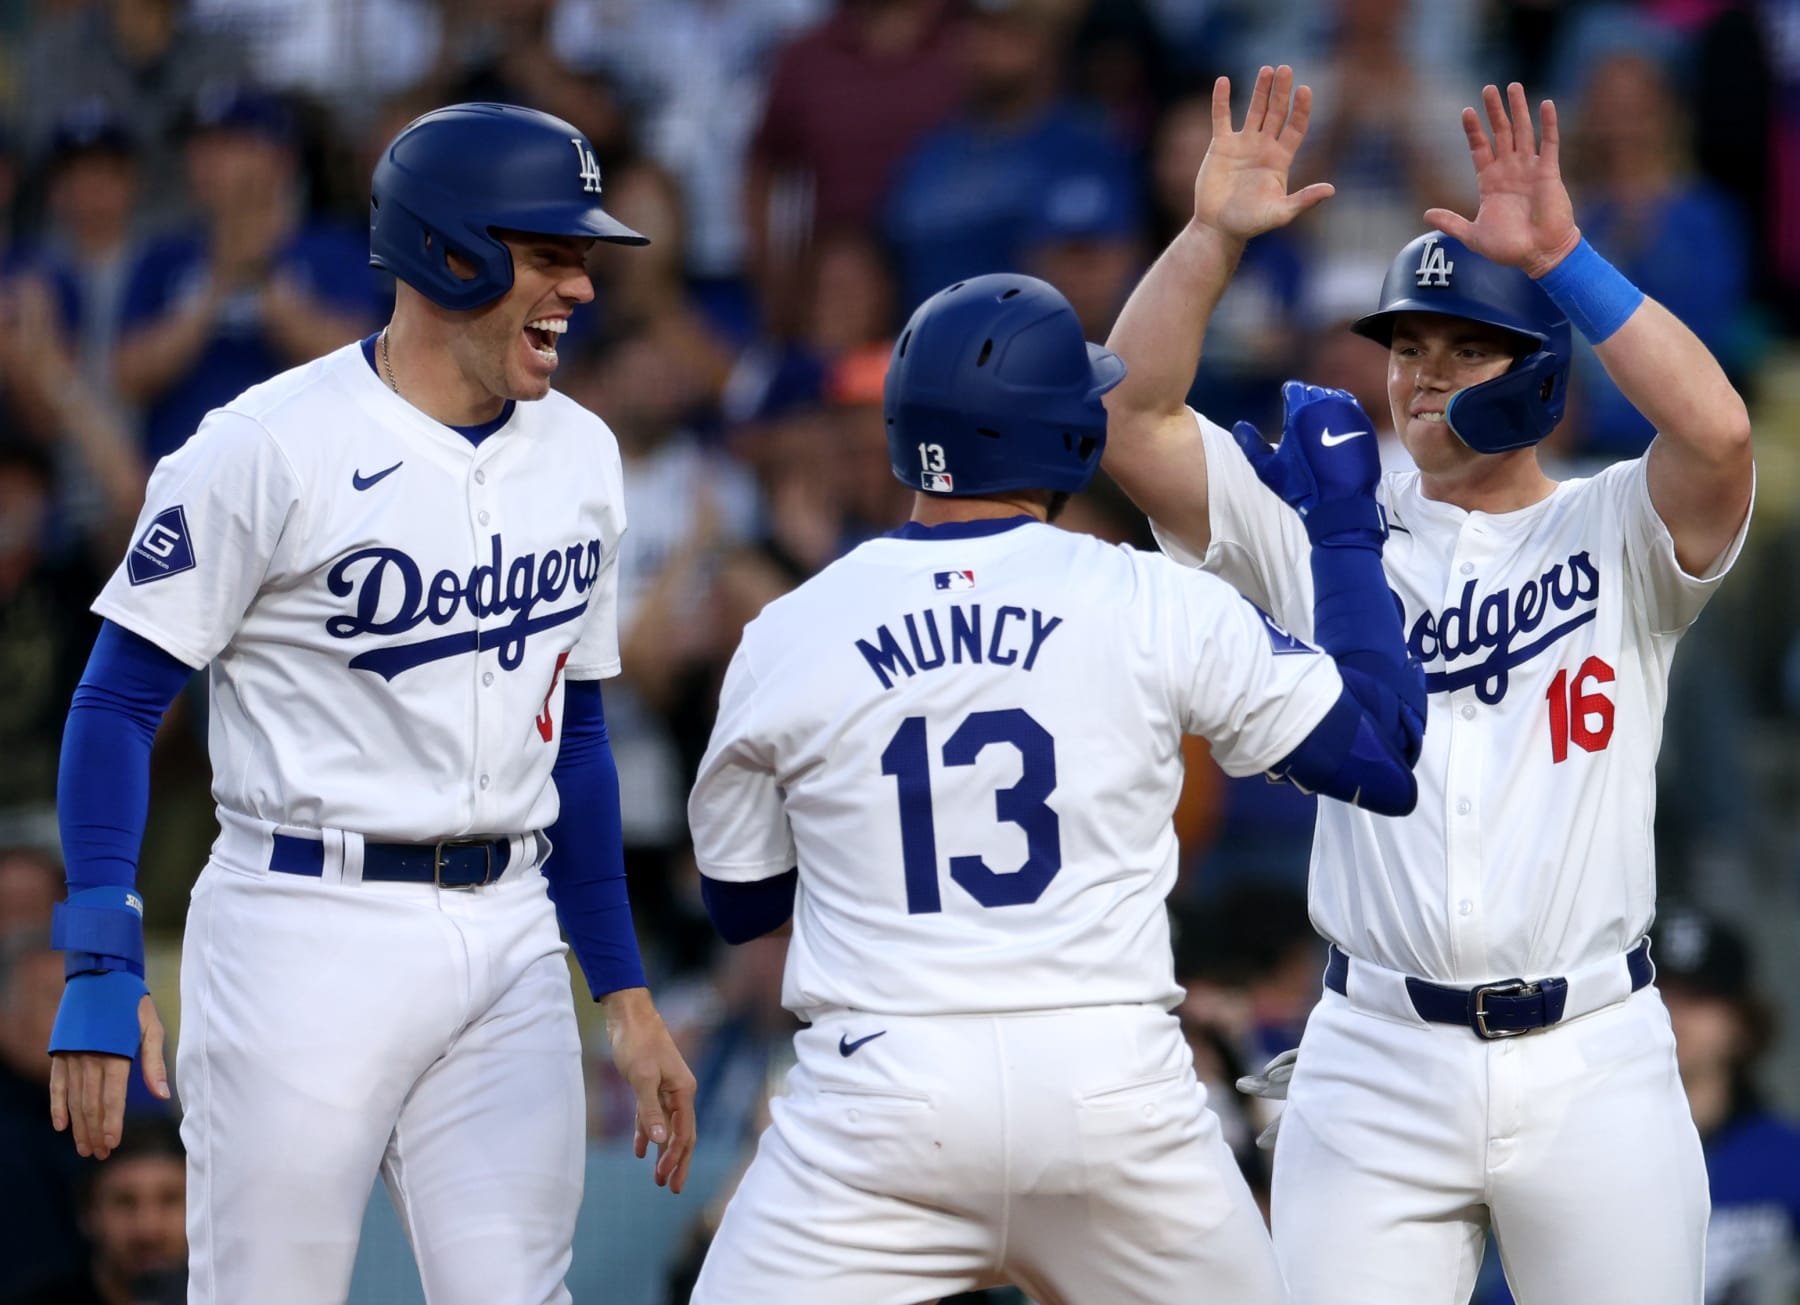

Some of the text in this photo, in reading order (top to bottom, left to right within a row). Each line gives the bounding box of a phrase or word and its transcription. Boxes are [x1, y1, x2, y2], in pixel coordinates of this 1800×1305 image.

[1415, 238, 1454, 287] LA
[918, 442, 946, 473] 13
[143, 523, 180, 558] G
[325, 533, 601, 671] Dodgers
[854, 604, 1064, 690] MUNCY
[1388, 550, 1600, 705] odgers
[1546, 655, 1616, 764] 16
[880, 708, 1062, 915] 13
